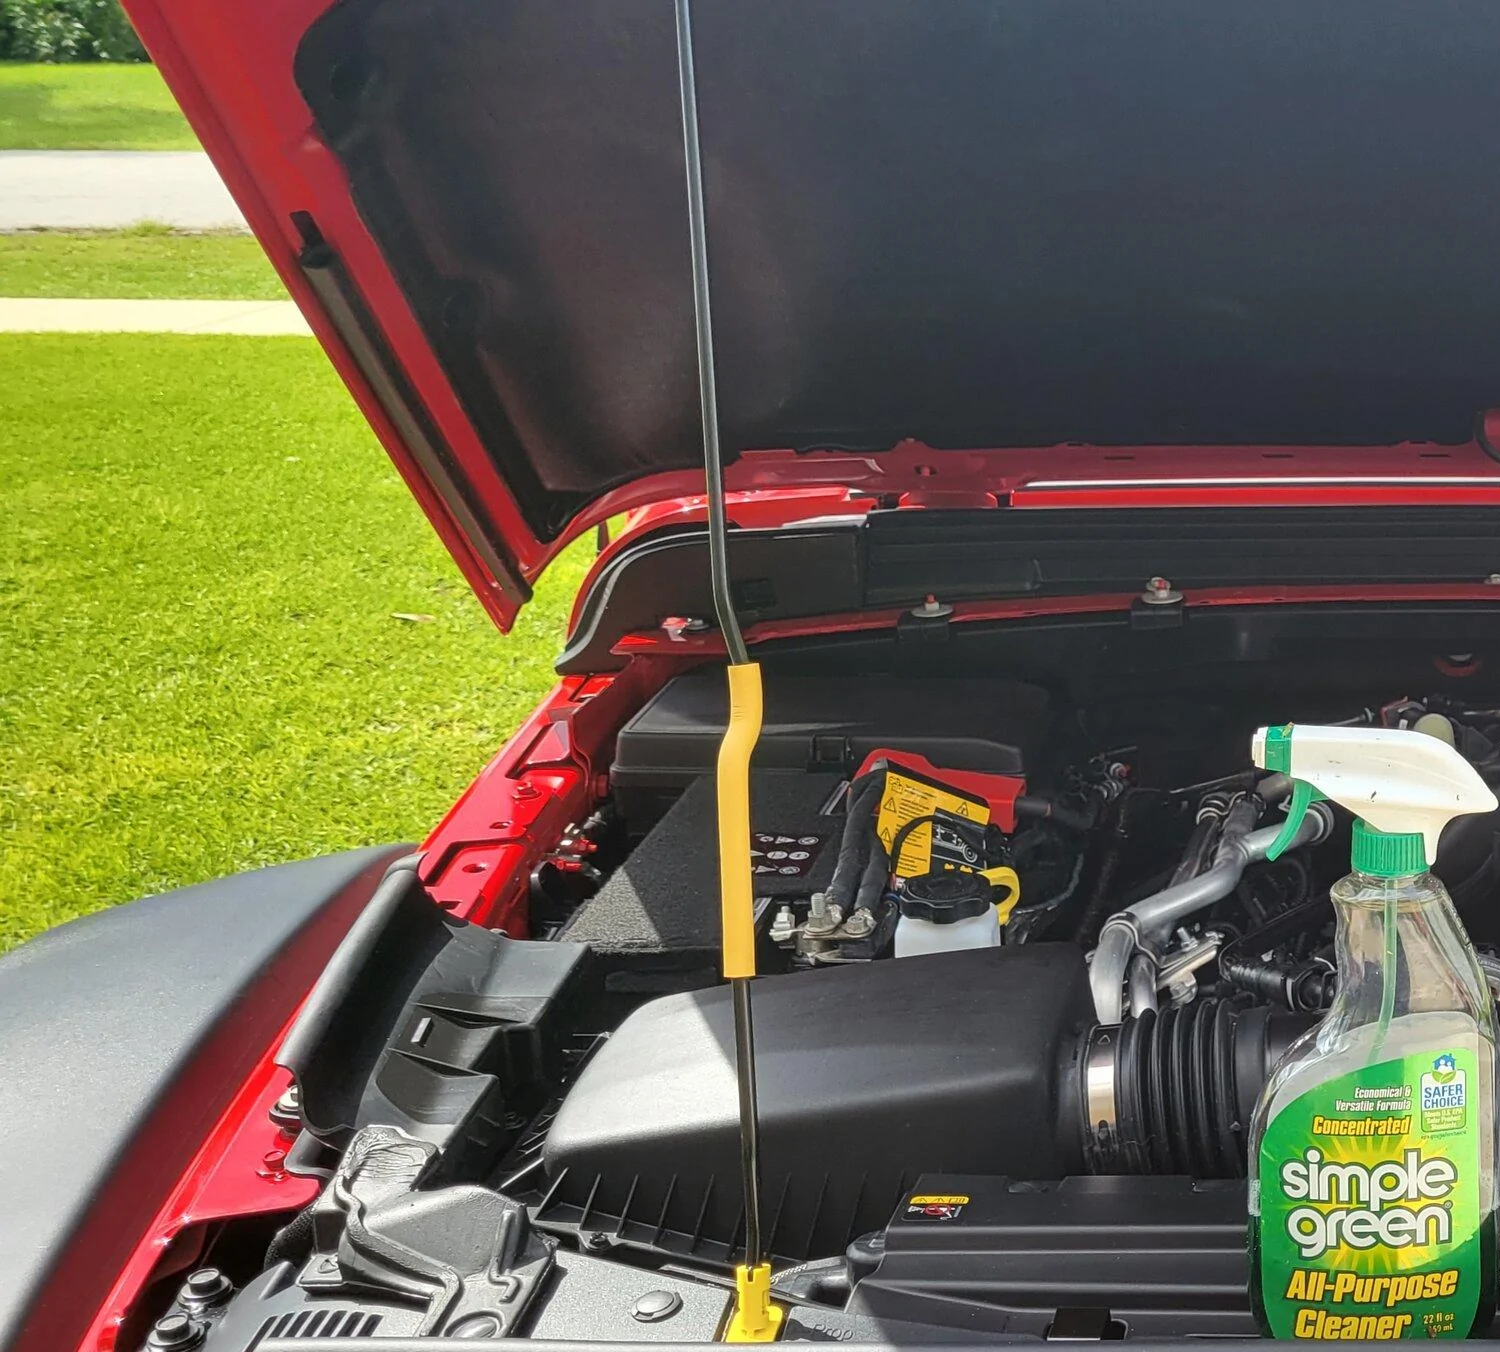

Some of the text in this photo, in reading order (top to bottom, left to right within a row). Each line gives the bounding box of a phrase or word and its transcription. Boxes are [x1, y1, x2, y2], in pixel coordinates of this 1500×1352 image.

[1354, 1085, 1412, 1099] Economical &
[1424, 1083, 1463, 1099] SAFER
[1335, 1099, 1412, 1112] Versatile Formula
[1424, 1095, 1464, 1109] CHOICE
[1312, 1115, 1411, 1136] Concentrated
[1281, 1148, 1456, 1212] simple
[1287, 1204, 1452, 1259] green
[1286, 1270, 1459, 1307] All-Purpose
[1294, 1309, 1412, 1340] Cleaner
[1423, 1314, 1434, 1325] 22
[1444, 1313, 1455, 1321] oz
